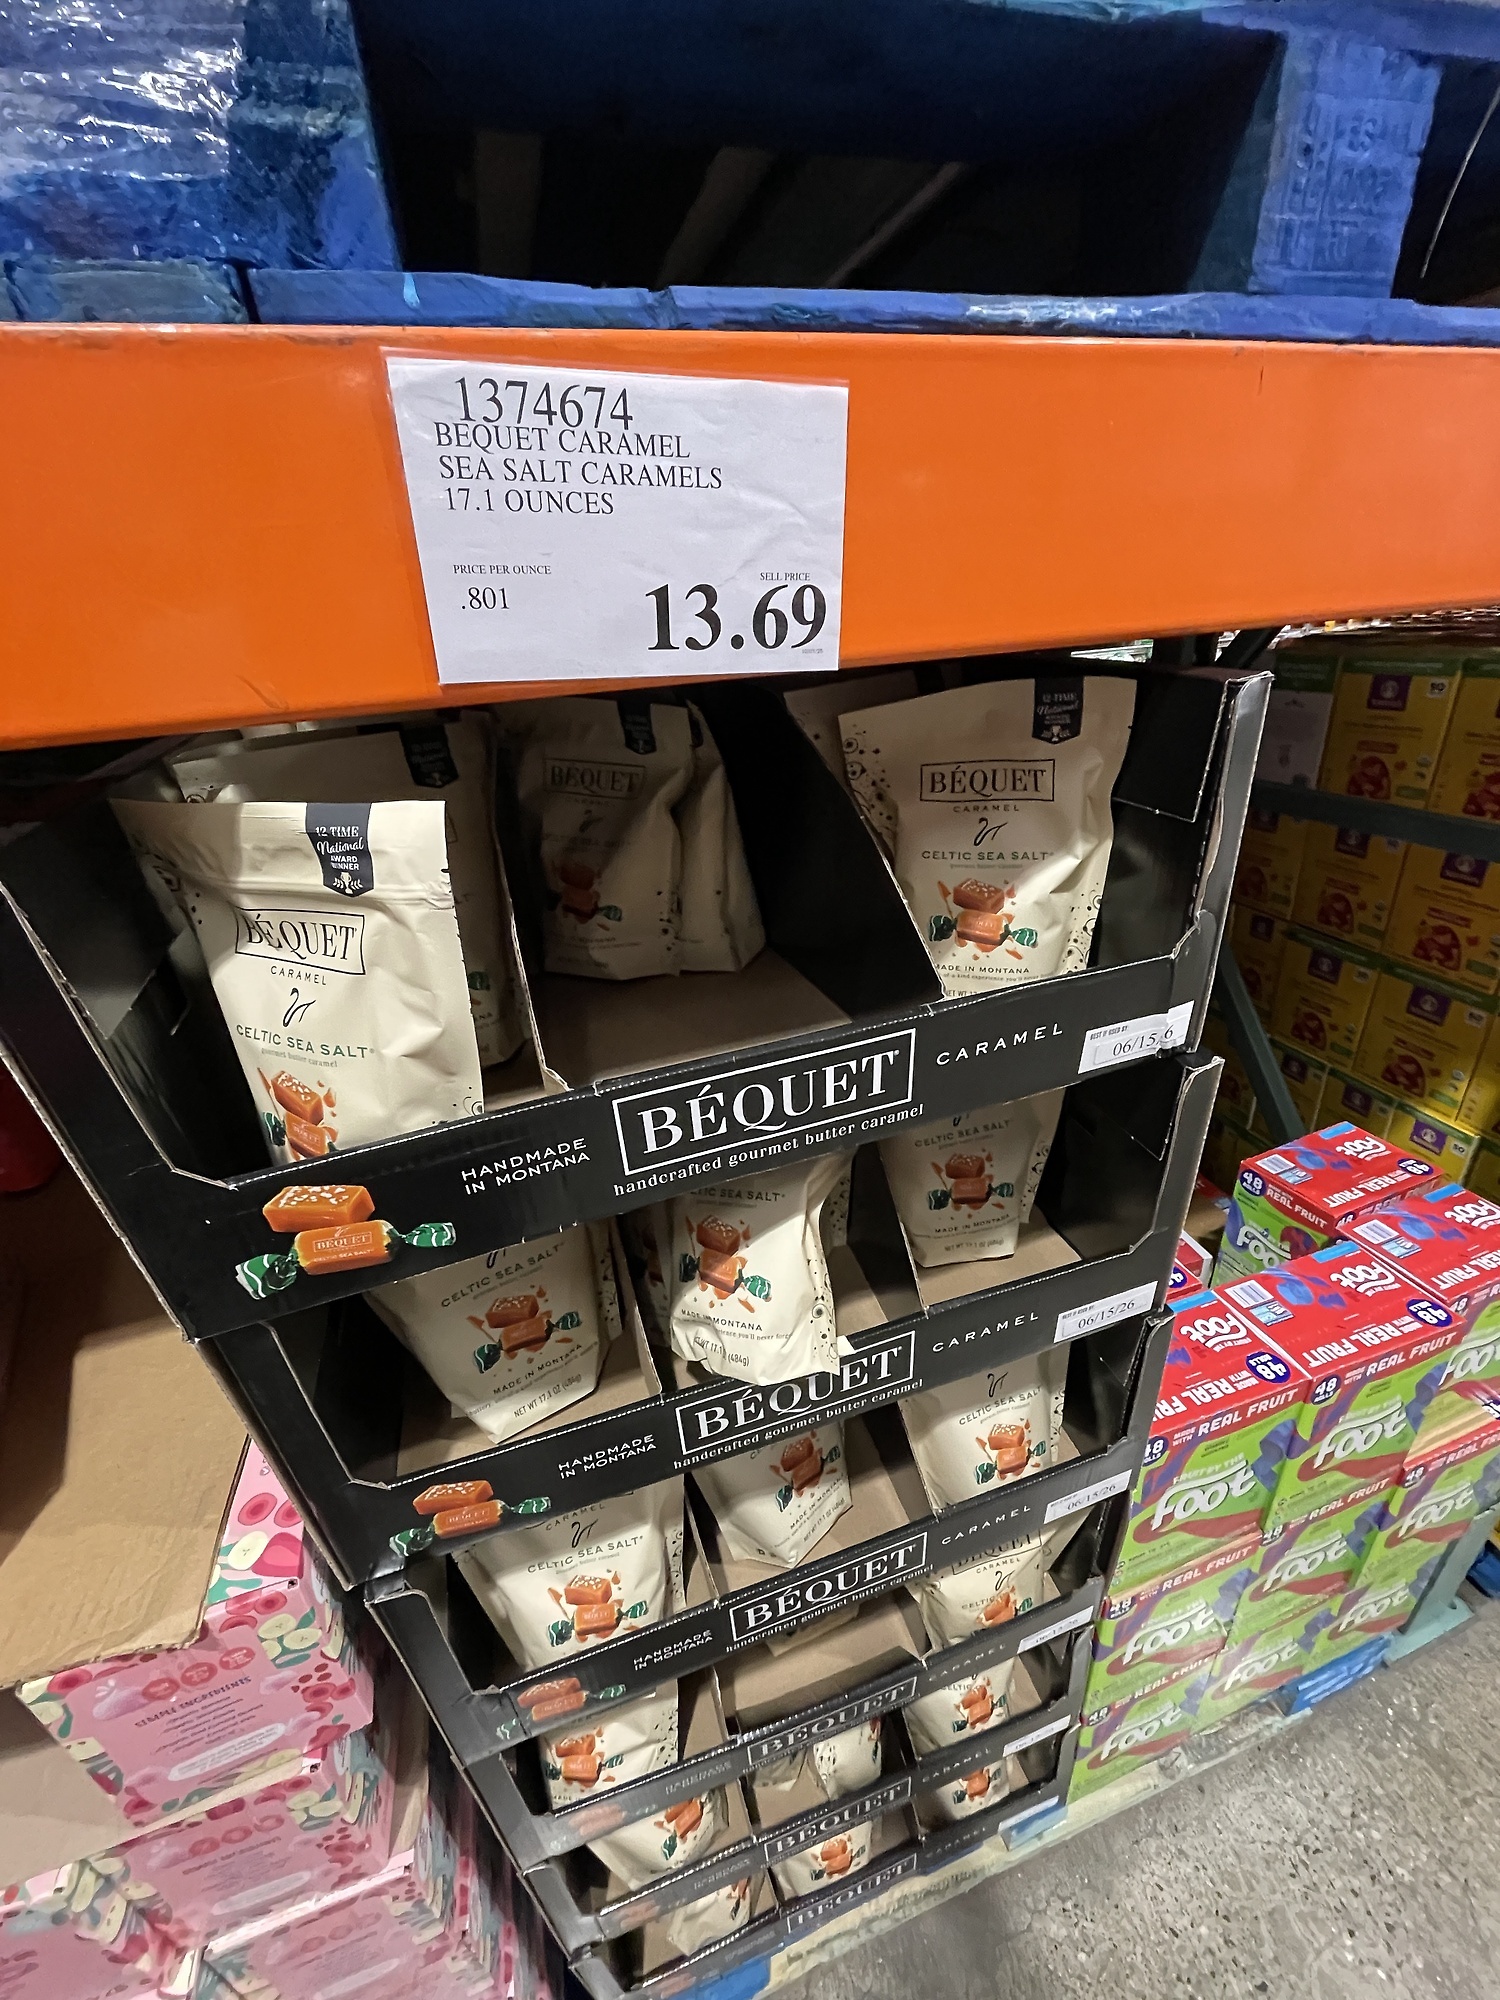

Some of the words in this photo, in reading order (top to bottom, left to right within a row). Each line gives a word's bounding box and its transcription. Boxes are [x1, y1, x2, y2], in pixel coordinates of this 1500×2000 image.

[454, 376, 634, 430] 1374674
[433, 422, 550, 453] BEQUET
[558, 429, 691, 459] CARAMEL
[439, 455, 495, 481] SEA
[503, 458, 572, 484] SALT
[580, 461, 723, 489] CARAMELS
[444, 488, 494, 512] 17.1
[504, 490, 615, 515] OUNCES
[452, 564, 487, 575] PRICE
[488, 564, 511, 575] PER
[511, 564, 552, 576] OUNCE
[759, 571, 782, 581] SELL
[783, 571, 811, 581] PRICE
[460, 586, 510, 610] .801
[645, 583, 827, 652] 13.69
[929, 765, 1046, 797] BÉQUET
[952, 803, 1020, 813] CARAMEL
[315, 826, 329, 837] 12
[329, 825, 360, 838] TIME
[316, 836, 365, 856] National
[330, 855, 358, 863] AWARD
[921, 850, 972, 861] CELTIC
[977, 850, 1005, 861] SEA
[1011, 850, 1049, 861] SALT
[245, 913, 356, 962] BÉQUET
[270, 965, 327, 986] CARAMEL
[965, 964, 975, 972] IN
[980, 966, 1030, 975] MONTANA
[236, 1023, 282, 1047] CELTIC
[286, 1036, 315, 1056] SEA
[320, 1042, 370, 1060] SALT
[936, 1022, 1063, 1067] CARAMEL
[636, 1051, 897, 1155] BÉQUET
[914, 1132, 955, 1149] CELTIC
[957, 1125, 980, 1138] SEA
[983, 1119, 1010, 1133] SALT
[460, 1136, 588, 1183] HANDMADE
[613, 1157, 723, 1197] handcrafted
[728, 1139, 800, 1169] gourmet
[804, 1121, 857, 1147] butter
[860, 1103, 926, 1135] caramel
[463, 1180, 487, 1196] IN
[496, 1151, 591, 1188] MONTANA
[1242, 1172, 1263, 1190] 48
[1356, 1175, 1397, 1192] REAL
[720, 1188, 743, 1200] SEA
[747, 1189, 780, 1202] SALT
[1266, 1188, 1293, 1210] REAL
[1294, 1204, 1328, 1229] FRUIT
[1322, 1187, 1366, 1208] FRUIT
[441, 1276, 492, 1308] CELTIC
[495, 1262, 524, 1281] SEA
[528, 1244, 561, 1268] SALT
[1430, 1263, 1481, 1291] FRUIT
[712, 1317, 763, 1332] MONTANA
[1077, 1299, 1136, 1329] 06/15/26
[1417, 1307, 1448, 1325] 48
[932, 1311, 1039, 1353] CARAMEL
[1349, 1322, 1403, 1348] REAL
[727, 1353, 750, 1367] (484g)
[1303, 1338, 1359, 1369] FRUIT
[1366, 1353, 1406, 1377] REAL
[1409, 1332, 1456, 1359] FRUIT
[493, 1377, 522, 1395] MADE
[525, 1370, 535, 1380] IN
[537, 1343, 582, 1371] MONTANA
[1256, 1361, 1288, 1380] 48
[694, 1348, 899, 1440] BÉQUET
[1180, 1378, 1237, 1406] REAL
[1315, 1377, 1338, 1397] 48
[513, 1406, 524, 1418] NET
[528, 1398, 539, 1410] WT
[959, 1403, 993, 1426] CELTIC
[993, 1395, 1017, 1410] SEA
[1018, 1385, 1043, 1403] SALT
[1197, 1411, 1243, 1437] REAL
[1246, 1388, 1299, 1418] FRUIT
[673, 1431, 760, 1471] handcrafted
[764, 1414, 822, 1441] gourmet
[826, 1397, 869, 1419] butter
[869, 1378, 925, 1404] caramel
[1173, 1427, 1197, 1440] MADE
[558, 1434, 655, 1471] HANDMADE
[1172, 1434, 1193, 1447] WITH
[1446, 1443, 1478, 1465] REAL
[560, 1469, 577, 1480] IN
[583, 1442, 657, 1472] MONTANA
[1404, 1465, 1424, 1482] 48
[1347, 1478, 1390, 1503] FRUIT
[545, 1502, 606, 1532] CARAMEL
[941, 1504, 1031, 1546] CARAMEL
[527, 1556, 574, 1575] CELTIC
[577, 1544, 604, 1559] SEA
[607, 1535, 640, 1552] SALT
[976, 1557, 1021, 1574] CARAMEL
[1161, 1567, 1203, 1592] REAL
[1205, 1546, 1253, 1573] FRUIT
[744, 1544, 914, 1630] BÉQUET
[725, 1618, 797, 1653] handcrafted
[800, 1598, 848, 1624] gourmet
[633, 1628, 712, 1665] HANDMADE
[634, 1661, 647, 1671] IN
[653, 1635, 714, 1665] MONTANA
[1134, 1676, 1170, 1699] REAL
